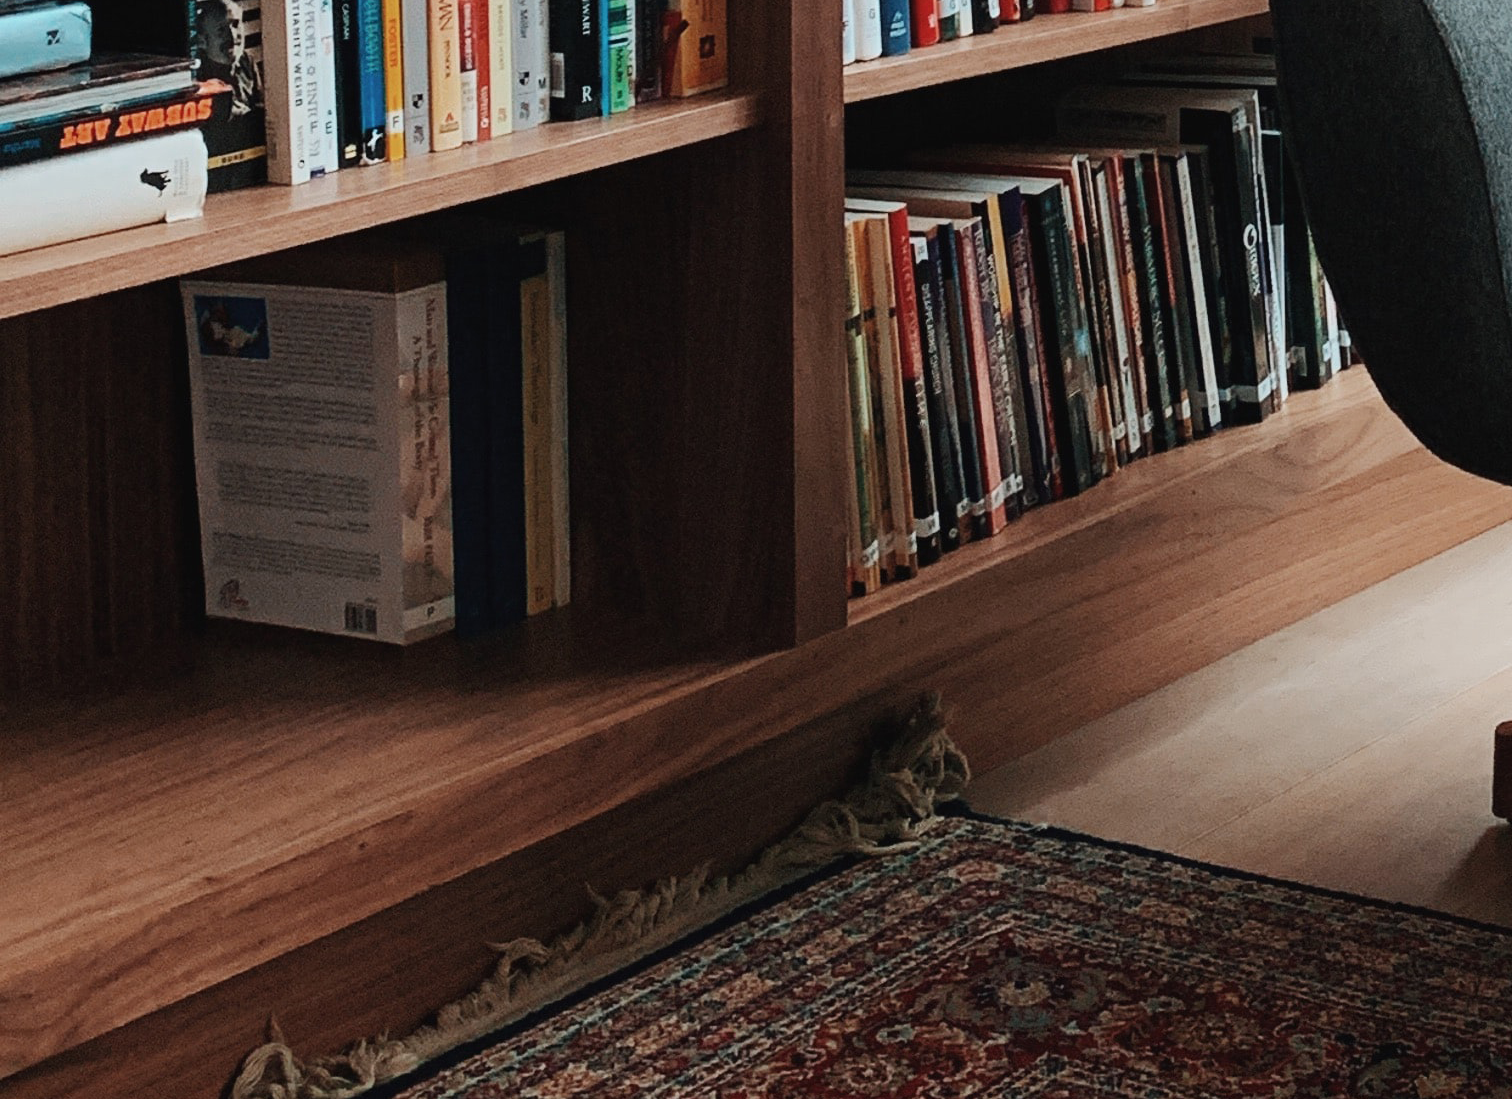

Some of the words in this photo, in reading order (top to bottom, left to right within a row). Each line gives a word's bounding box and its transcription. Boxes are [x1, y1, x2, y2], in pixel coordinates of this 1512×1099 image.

[304, 9, 314, 57] PEOPLE
[388, 19, 398, 67] FOSTER
[295, 63, 303, 107] WEIRD
[582, 85, 593, 102] R
[60, 118, 111, 149] ART
[115, 98, 213, 137] SUBWAY
[921, 283, 936, 353] DISAPPEARING
[931, 355, 942, 395] CHURCH
